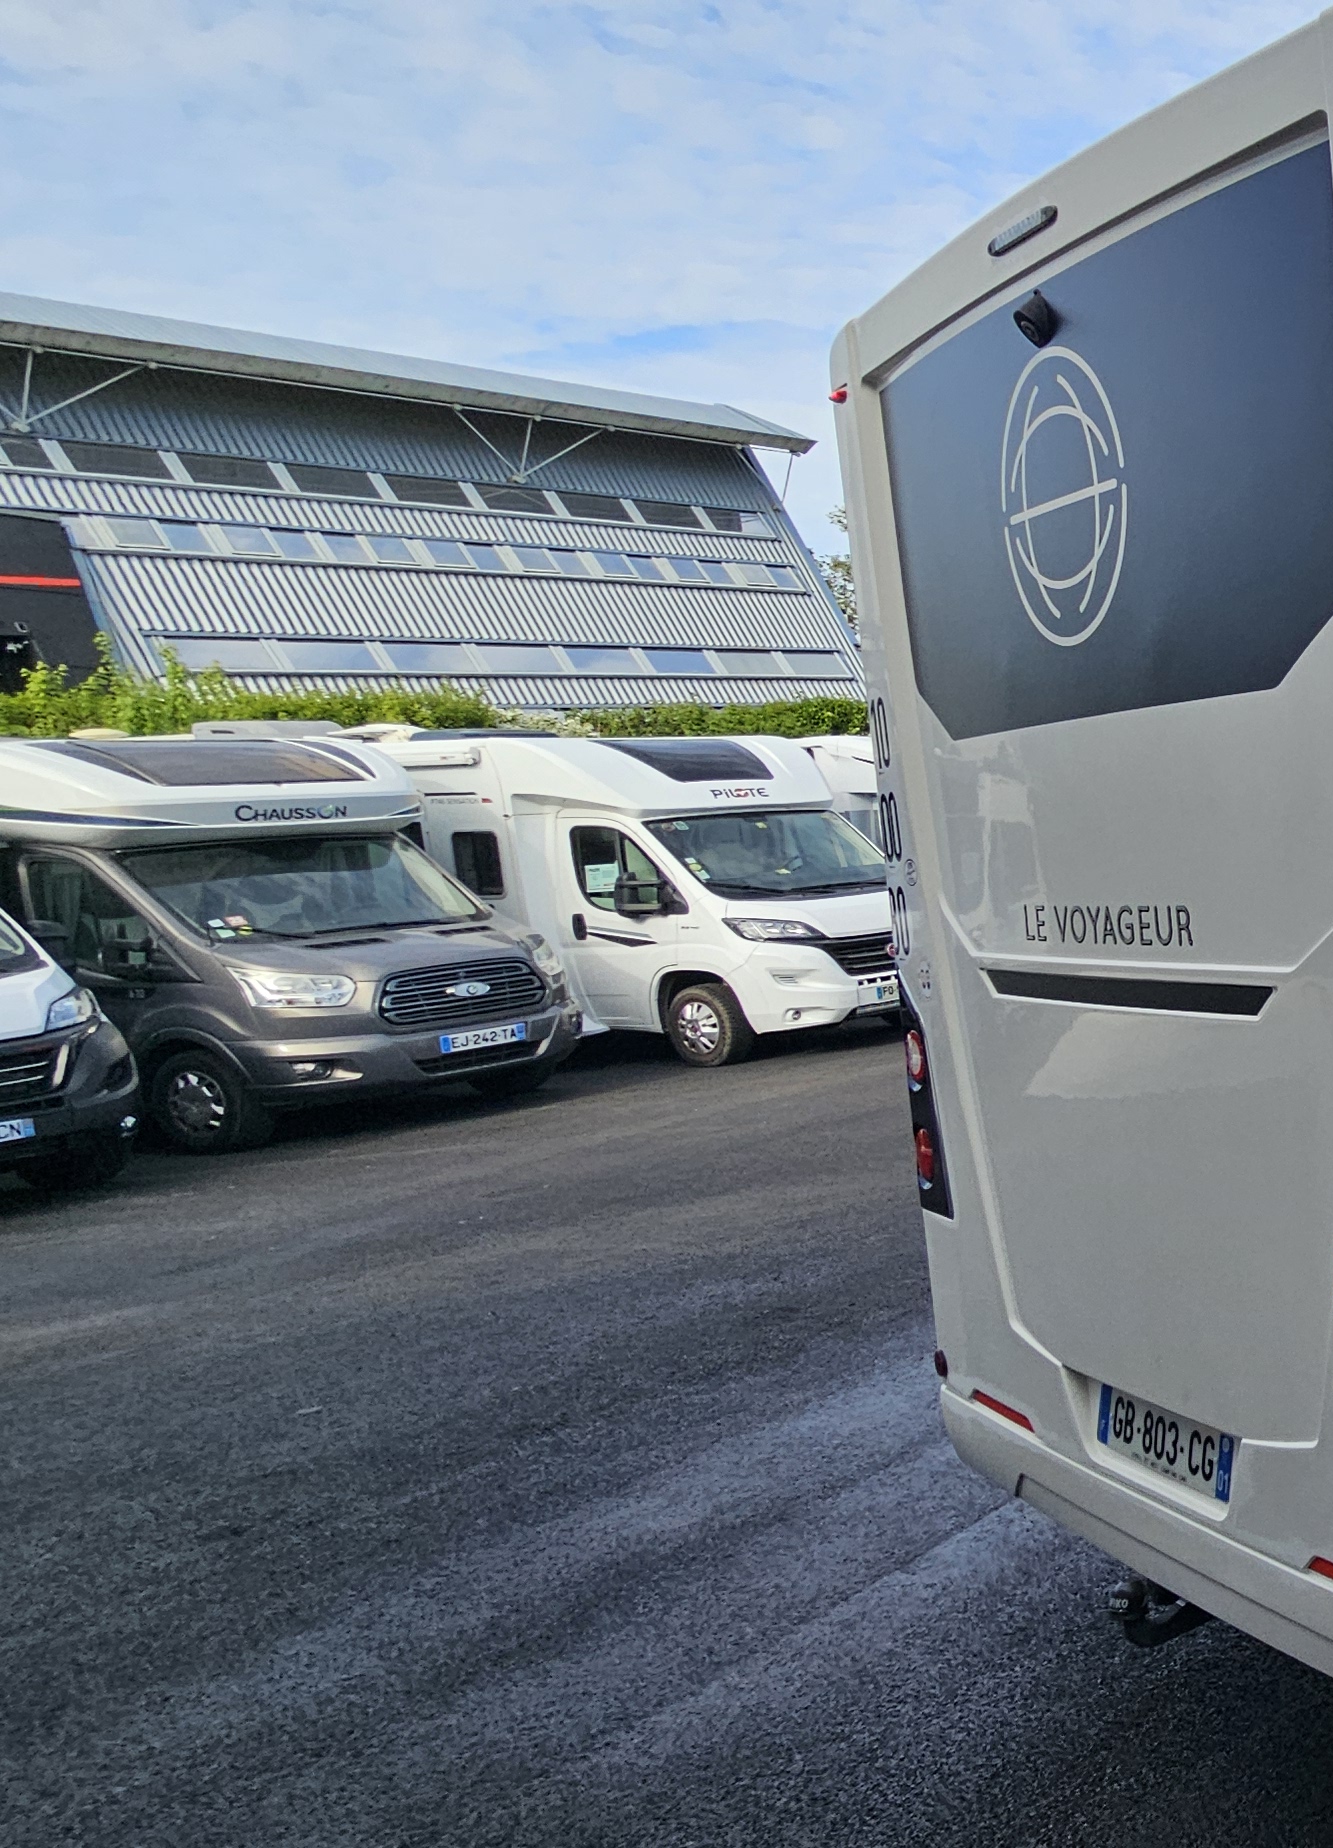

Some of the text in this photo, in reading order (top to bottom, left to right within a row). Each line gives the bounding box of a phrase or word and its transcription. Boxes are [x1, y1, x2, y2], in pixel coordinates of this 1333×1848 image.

[234, 805, 347, 821] CHAUSSON
[1023, 904, 1194, 947] LE VOYAGEUR
[451, 1028, 517, 1048] EJ-242-TA
[1217, 1469, 1229, 1494] 01
